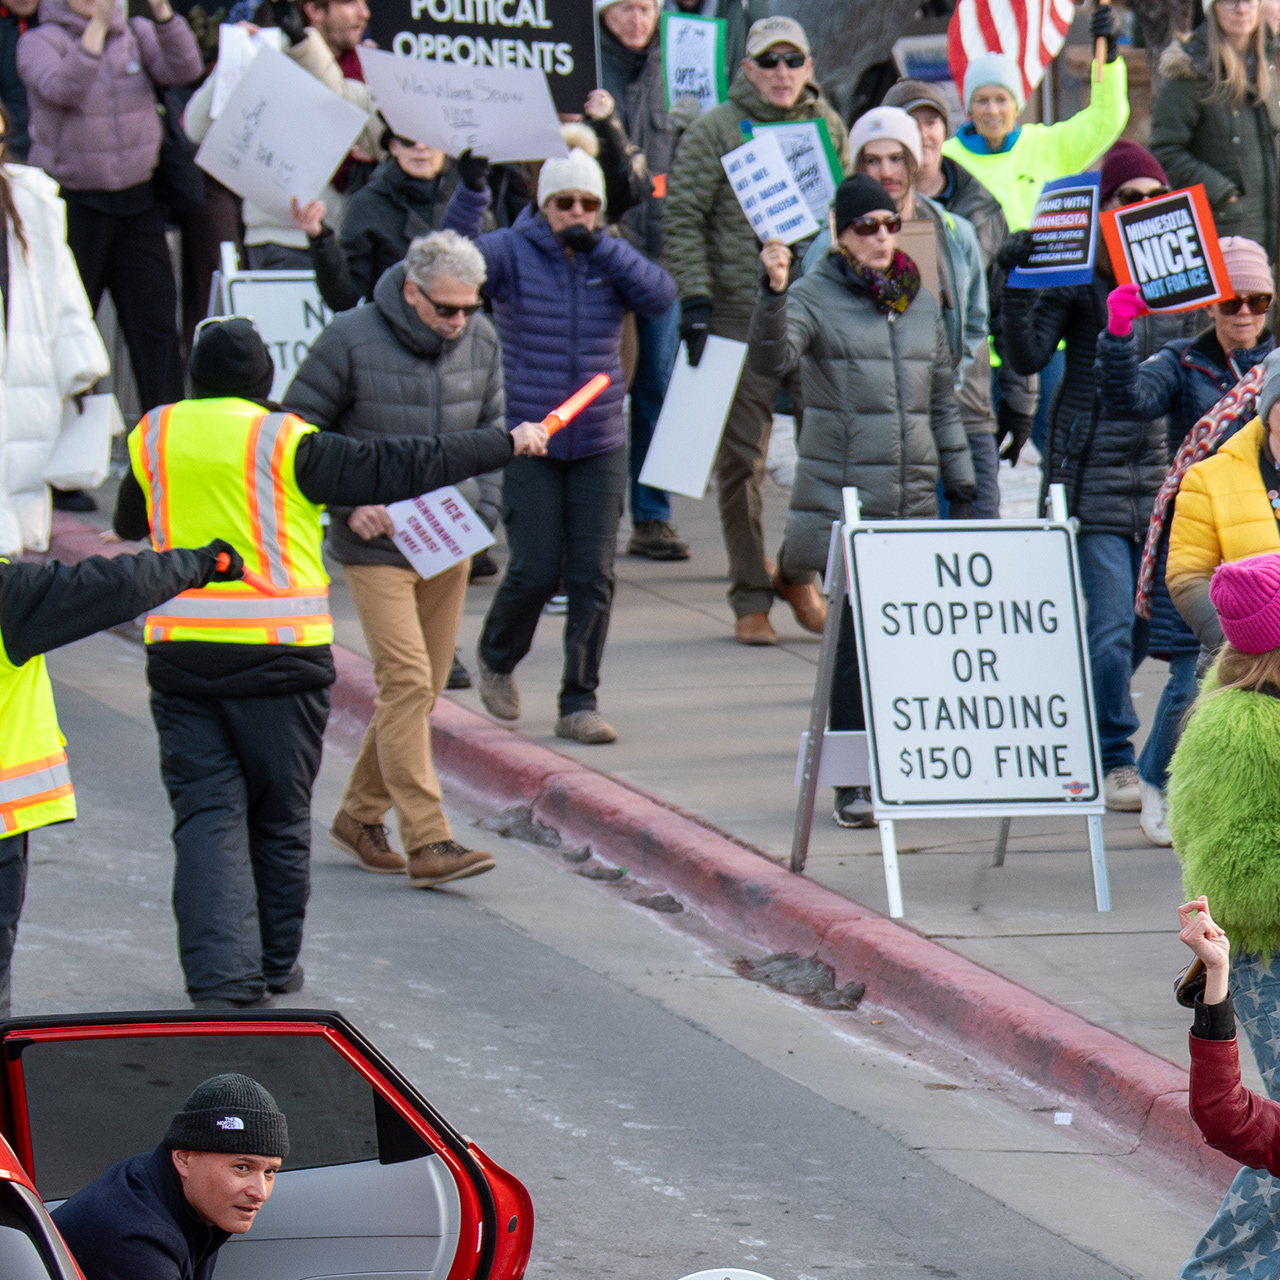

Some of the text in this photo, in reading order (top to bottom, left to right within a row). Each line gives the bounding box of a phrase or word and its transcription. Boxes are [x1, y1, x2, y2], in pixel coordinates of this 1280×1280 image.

[411, 0, 553, 29] POLITICAL
[393, 31, 575, 76] OPPONENTS
[1063, 195, 1090, 208] WITH
[1033, 231, 1058, 242] ECAUSE
[1125, 208, 1192, 243] MINNESOTA
[1130, 226, 1204, 283] NICE
[1141, 266, 1209, 300] NOT FOR ICE
[441, 497, 465, 523] ICE
[934, 551, 993, 588] NO
[881, 599, 1058, 636] STOPPING
[952, 648, 999, 682] OR
[891, 694, 1068, 731] STANDING
[900, 744, 1072, 780] $150 FINE
